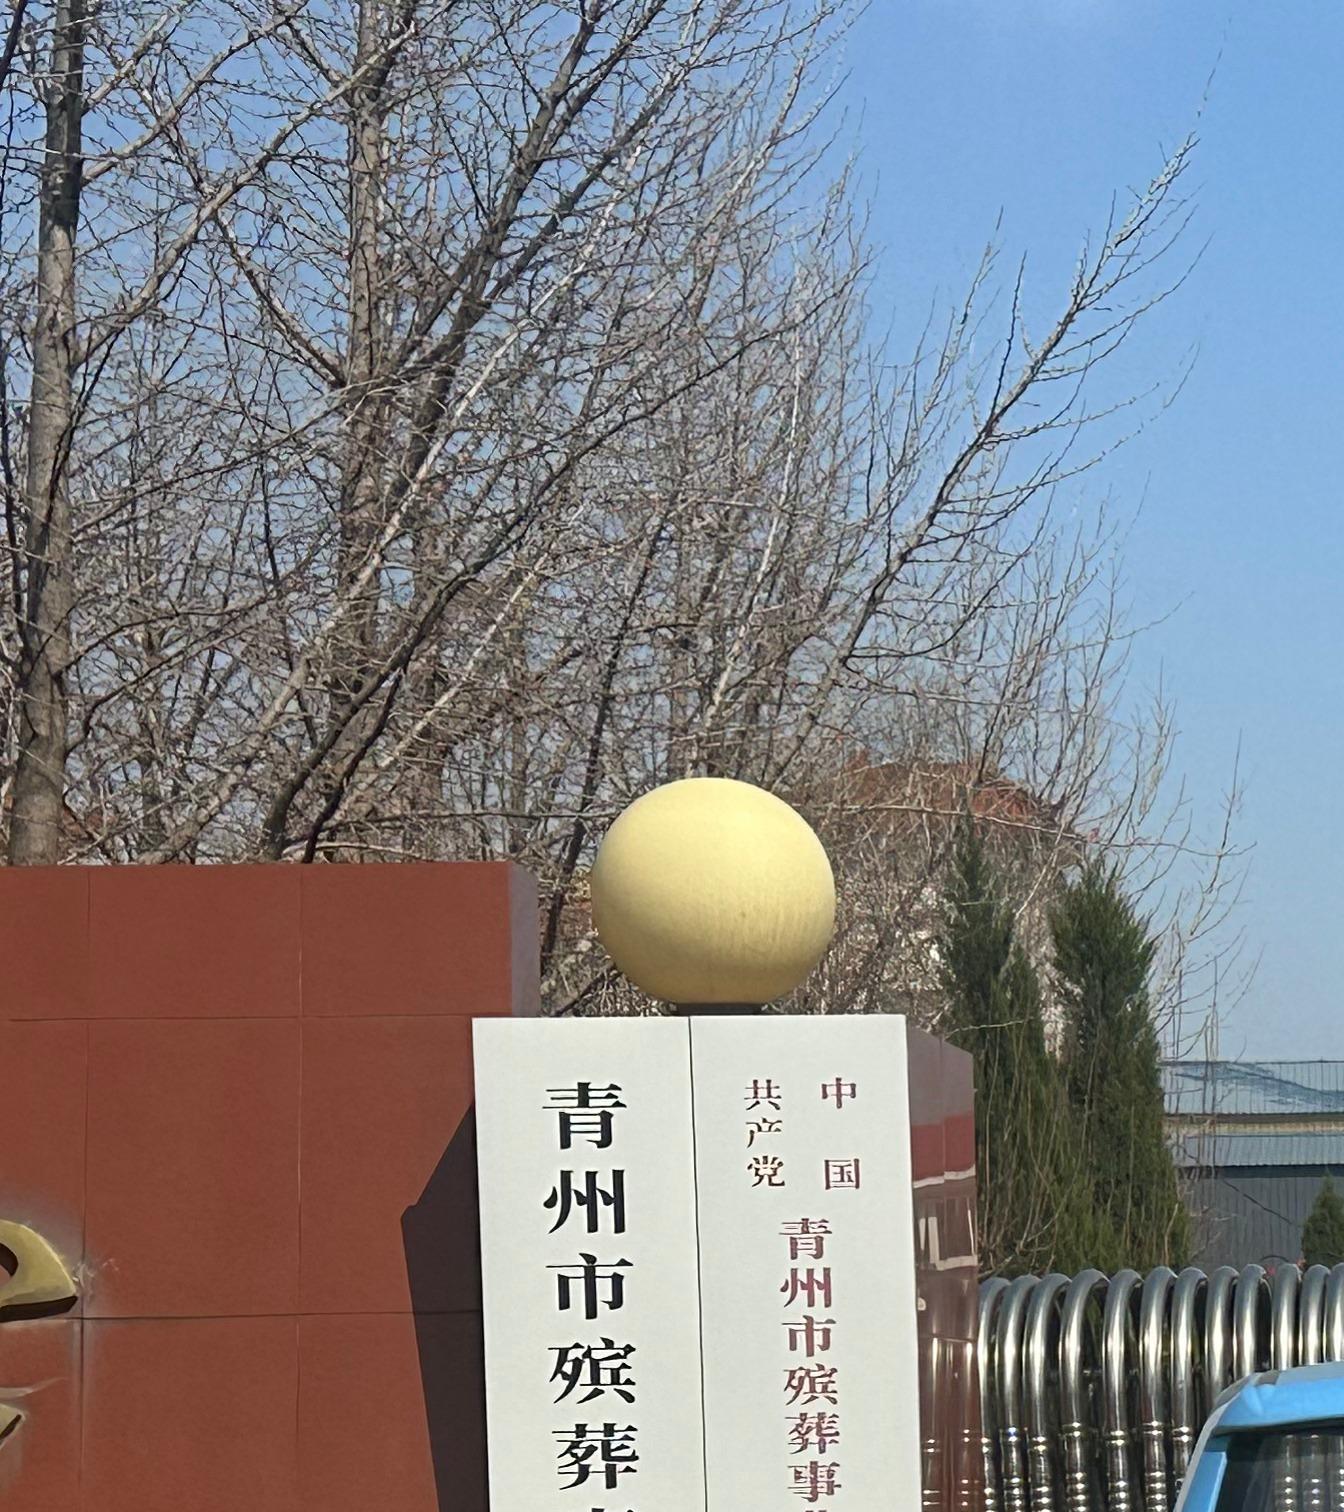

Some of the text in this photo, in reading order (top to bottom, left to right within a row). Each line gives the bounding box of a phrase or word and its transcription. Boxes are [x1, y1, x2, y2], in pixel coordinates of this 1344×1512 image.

[744, 1079, 786, 1189] 共产党
[821, 1077, 861, 1191] 中国
